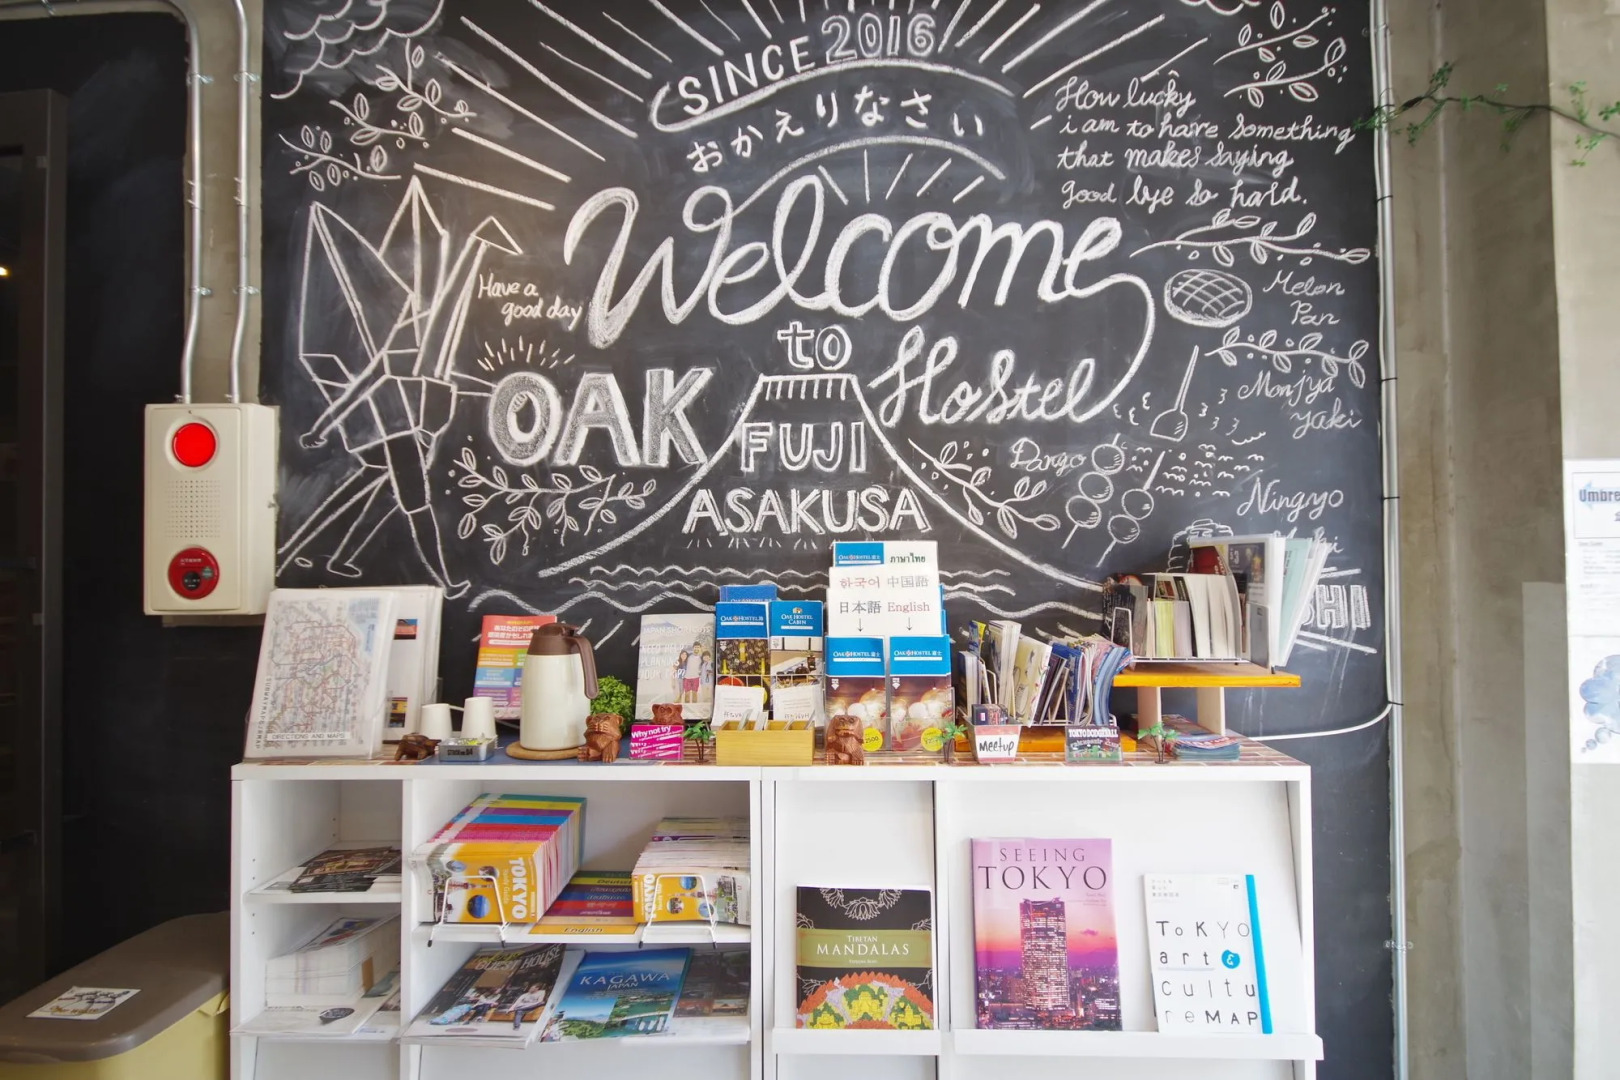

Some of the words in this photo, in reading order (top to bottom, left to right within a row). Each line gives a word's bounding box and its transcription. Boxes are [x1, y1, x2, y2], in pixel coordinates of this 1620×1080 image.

[678, 36, 816, 116] SINCE
[821, 12, 936, 64] 2016
[1055, 76, 1120, 112] How
[1123, 77, 1197, 118] lucky
[686, 85, 983, 173] おかえりなさい
[1081, 117, 1120, 134] am
[1126, 117, 1155, 138] to
[1057, 140, 1115, 170] that
[1124, 142, 1202, 170] makes
[1061, 180, 1118, 210] good
[563, 174, 1128, 348] Welcome
[477, 272, 521, 299] Have
[523, 283, 539, 297] a
[1262, 269, 1346, 296] Melon
[501, 297, 543, 327] good
[546, 294, 583, 331] day
[1289, 299, 1340, 326] Pan
[776, 320, 853, 370] to
[487, 366, 715, 468] OAK
[740, 420, 869, 473] FUJI
[1009, 436, 1088, 477] Dango
[681, 485, 934, 536] ASAKUSA
[1236, 476, 1345, 522] Ningyo
[840, 576, 880, 589] 한국어
[887, 575, 929, 588] 中国語
[840, 600, 882, 615] 日本語
[887, 601, 931, 614] English
[631, 730, 648, 739] Why
[648, 727, 661, 735] not
[661, 725, 671, 733] try
[999, 847, 1085, 862] SEEING
[509, 857, 527, 919] TOKYO
[978, 865, 1107, 891] TOKYO
[816, 943, 910, 956] MANDALAS
[1159, 951, 1210, 966] art
[580, 972, 670, 985] KAGAWA
[607, 982, 639, 991] JAPAN
